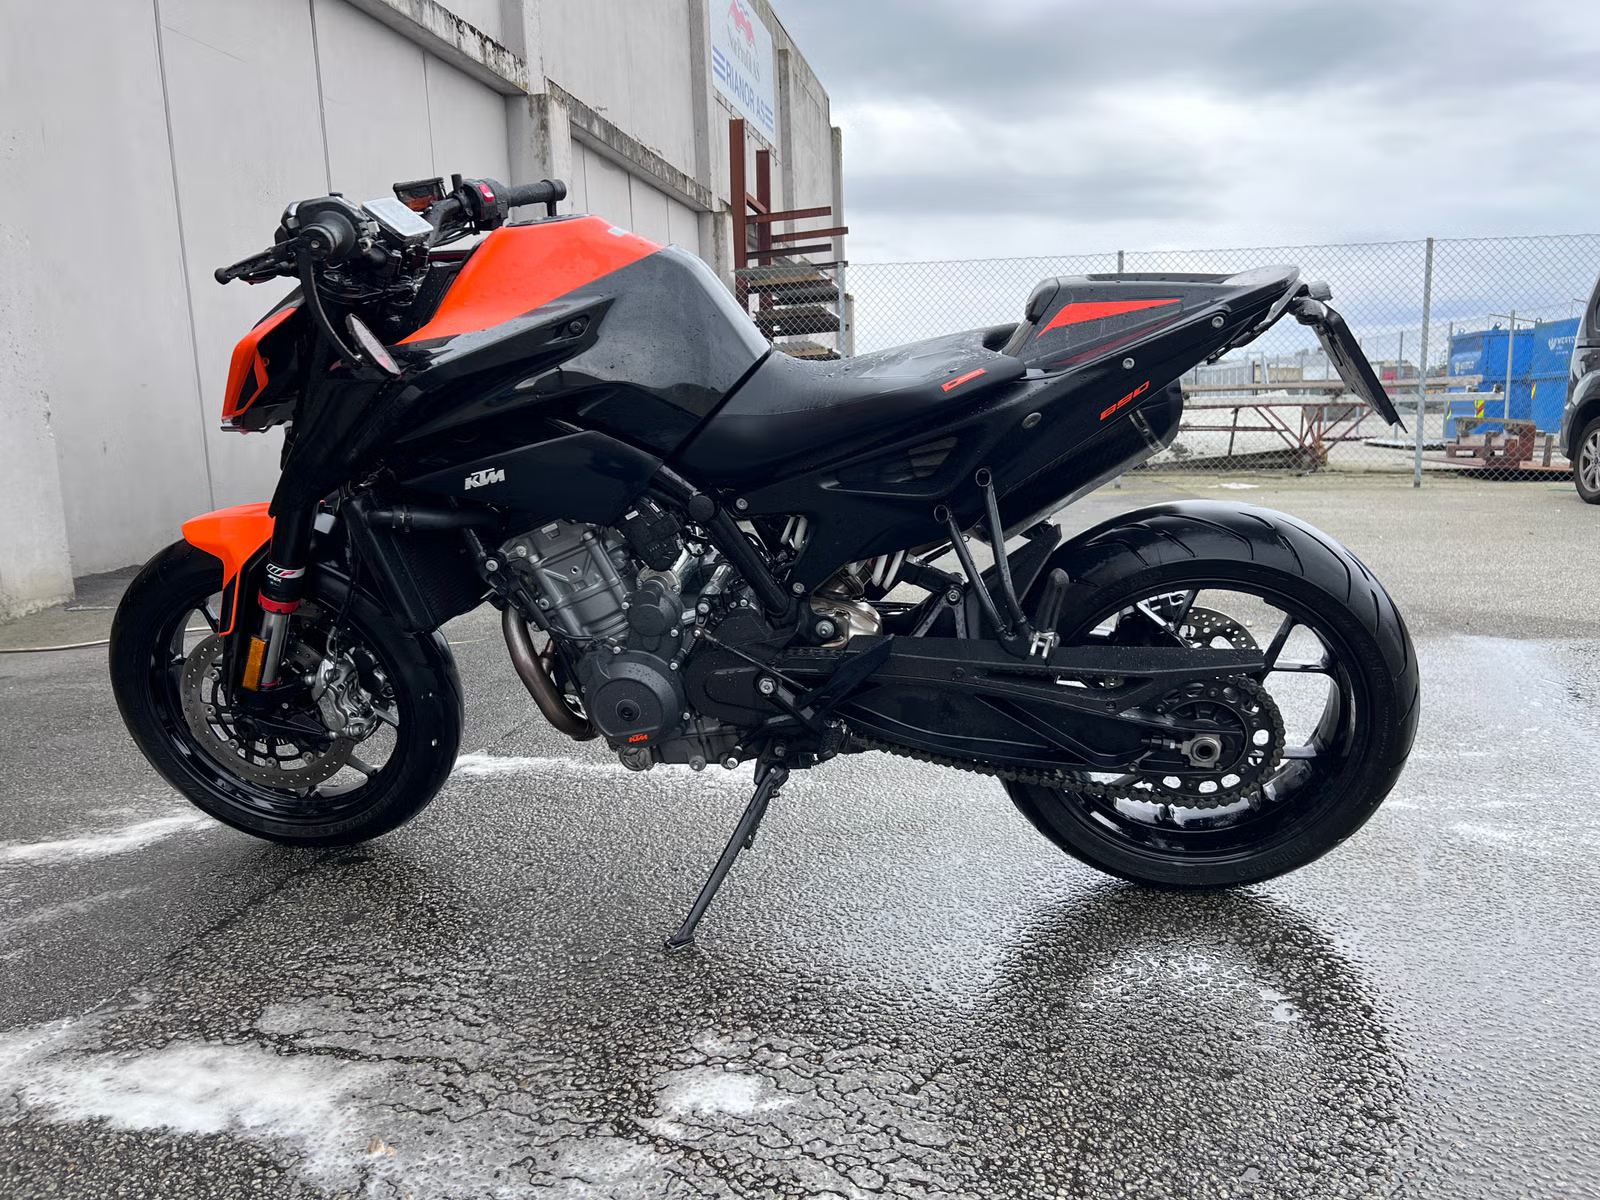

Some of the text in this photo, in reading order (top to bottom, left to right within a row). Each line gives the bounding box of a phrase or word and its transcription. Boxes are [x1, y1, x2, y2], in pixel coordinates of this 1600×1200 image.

[726, 59, 765, 124] RIANOR AS
[1100, 381, 1150, 420] 890
[464, 467, 505, 490] KTM
[628, 734, 648, 743] KTM
